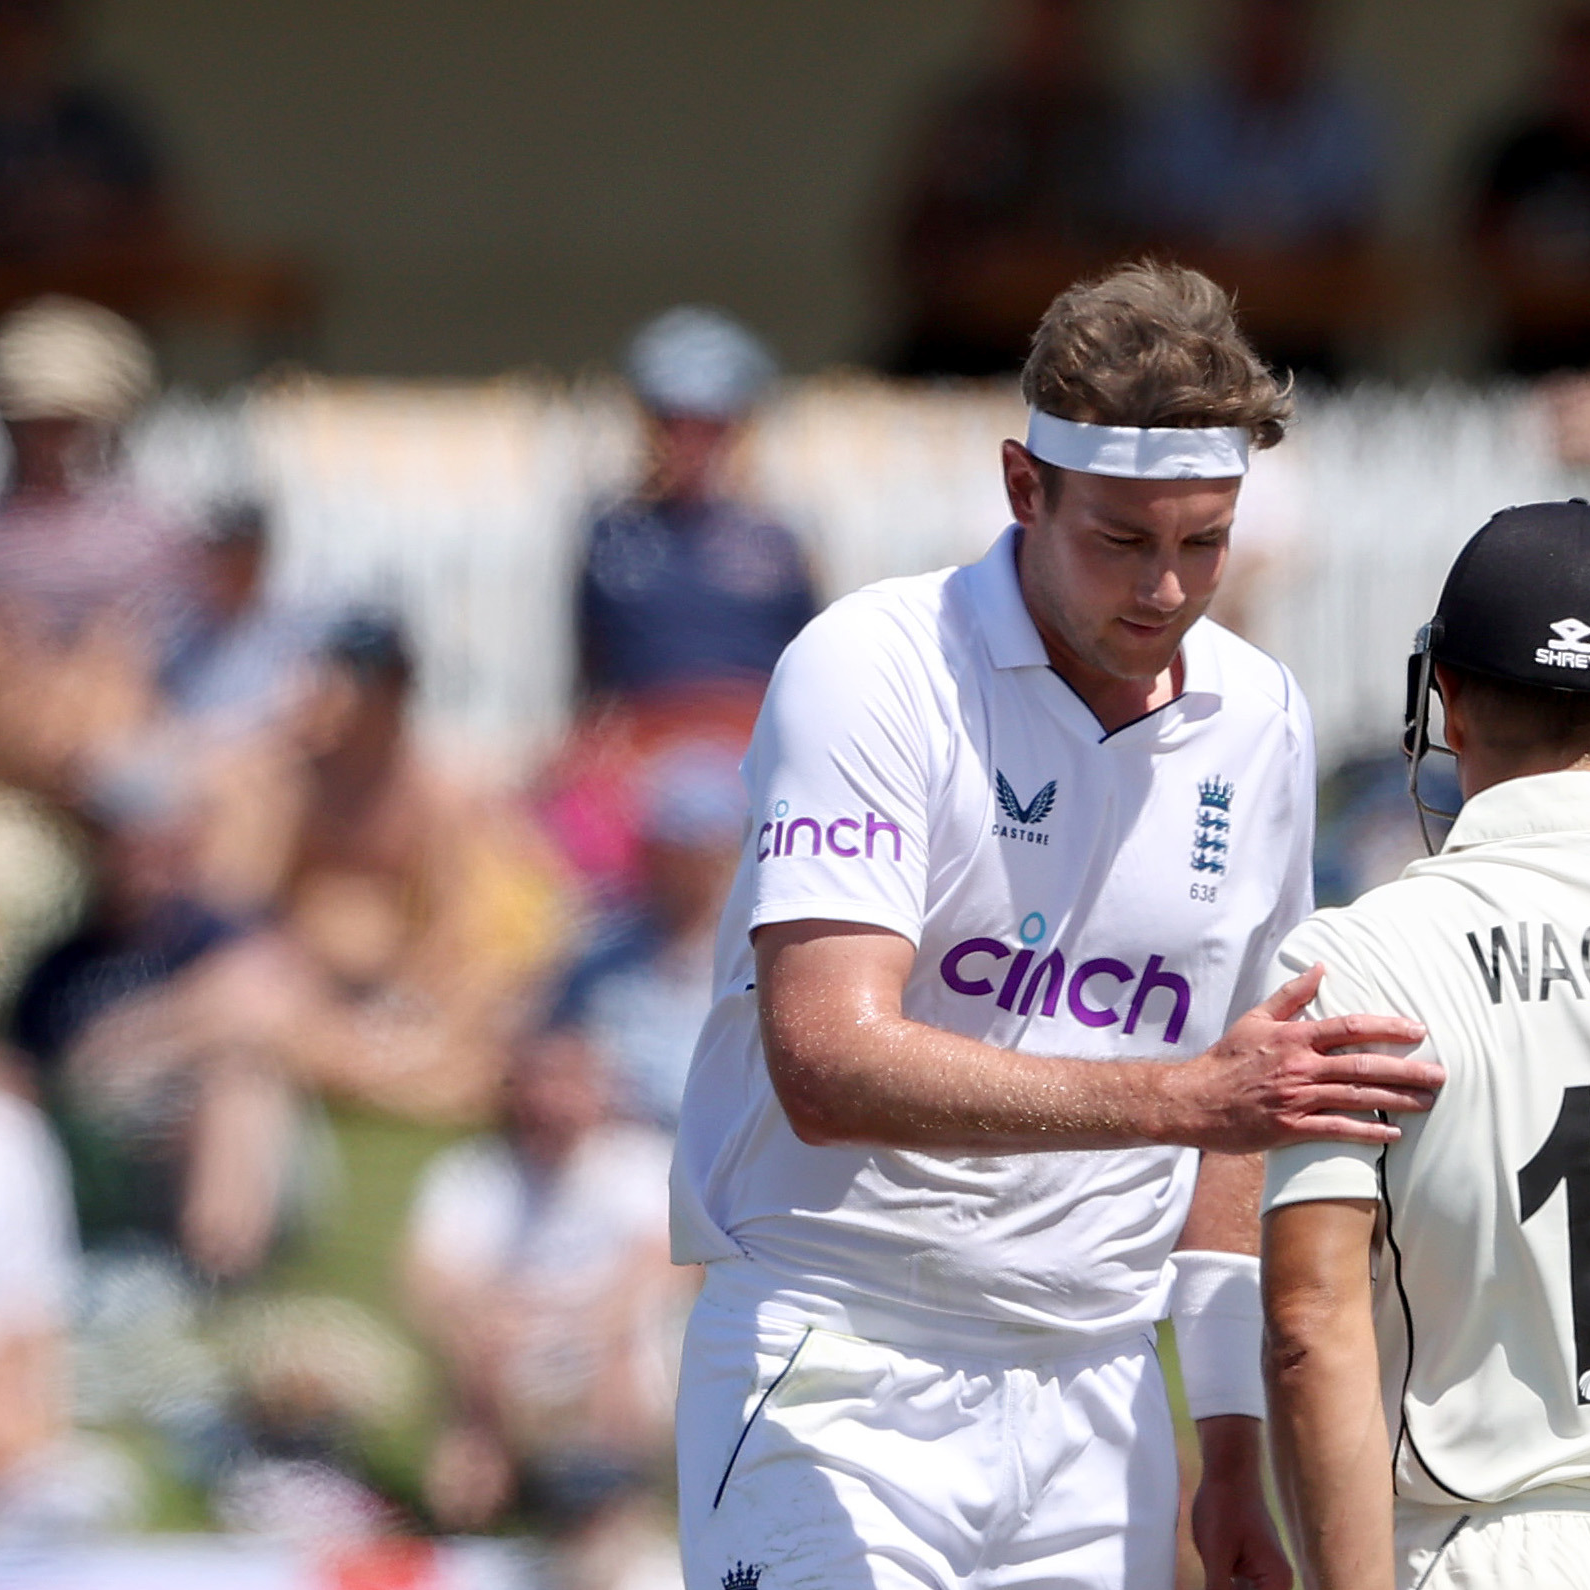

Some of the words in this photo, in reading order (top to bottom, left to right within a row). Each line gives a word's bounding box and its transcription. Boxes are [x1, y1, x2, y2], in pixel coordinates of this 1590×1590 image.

[757, 799, 902, 863] cinch
[992, 824, 1049, 846] CASTORE
[1190, 883, 1217, 903] 638
[940, 912, 1190, 1044] cinch
